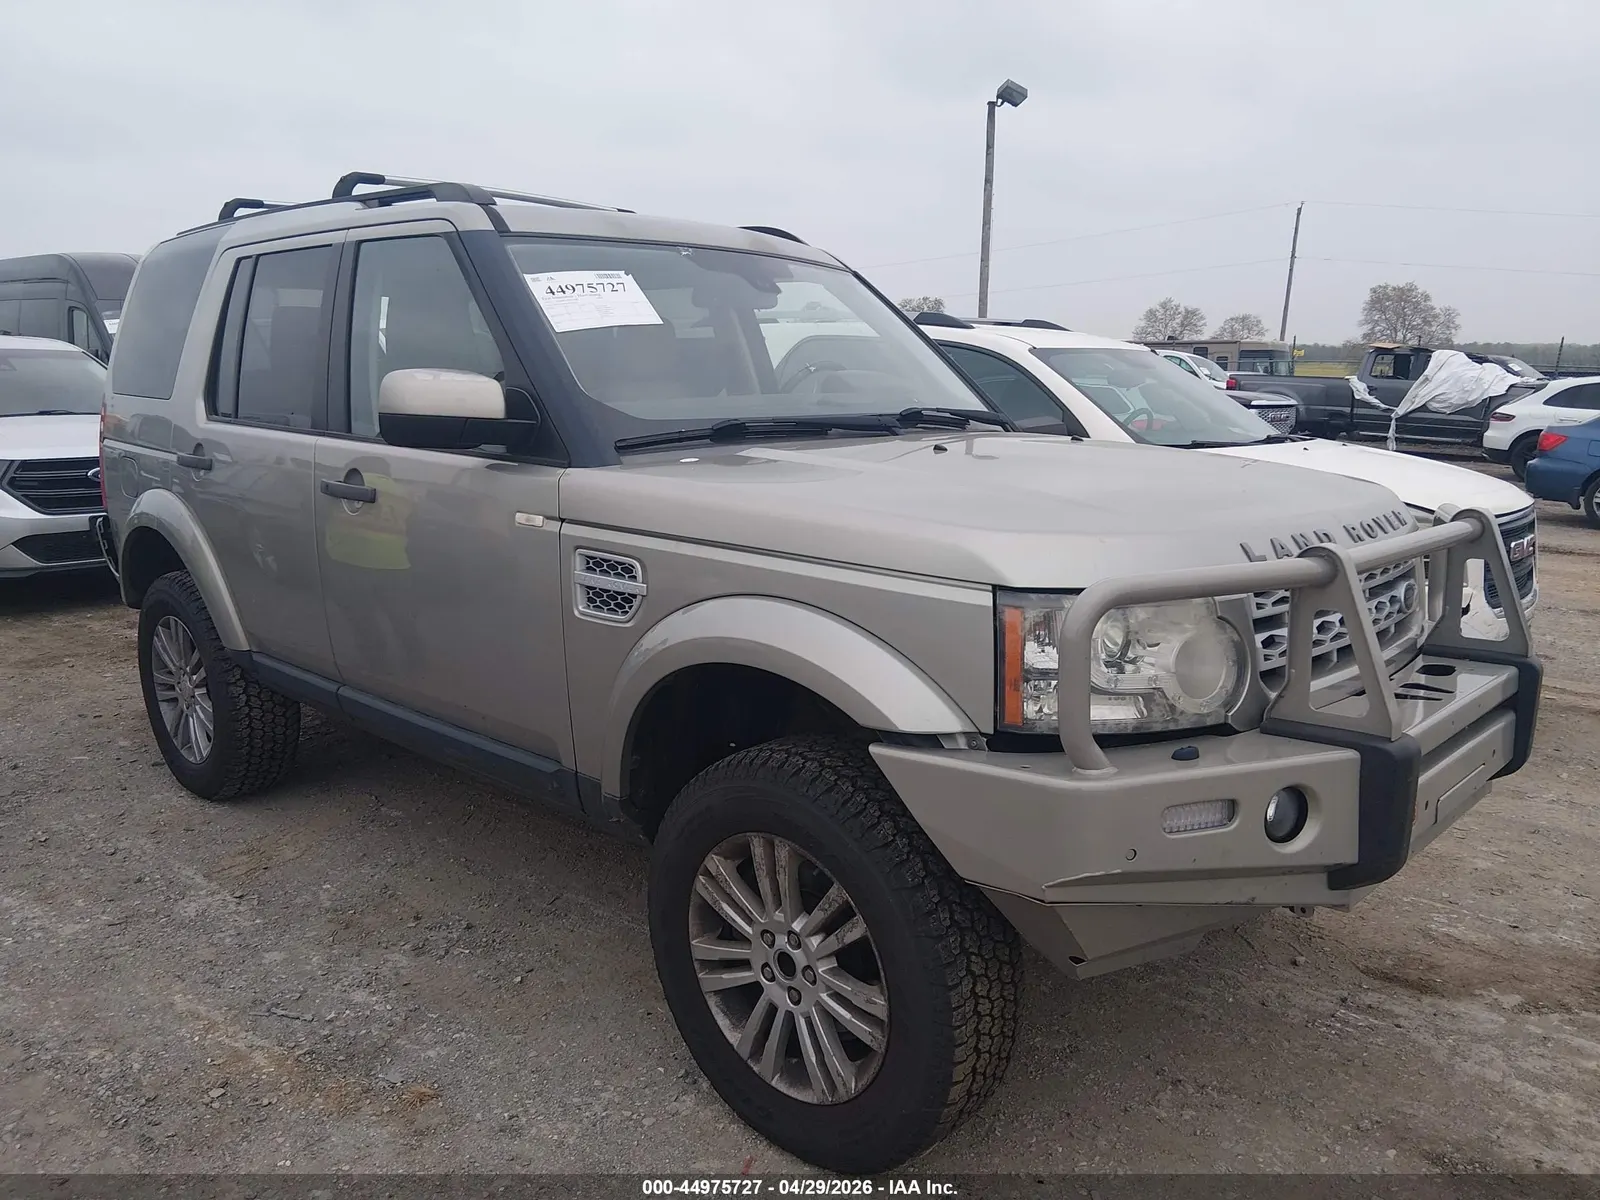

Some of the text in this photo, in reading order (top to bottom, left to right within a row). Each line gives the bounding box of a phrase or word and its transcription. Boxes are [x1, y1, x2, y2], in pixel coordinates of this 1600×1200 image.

[545, 282, 627, 296] 44975727
[1239, 510, 1408, 563] LAND ROVER
